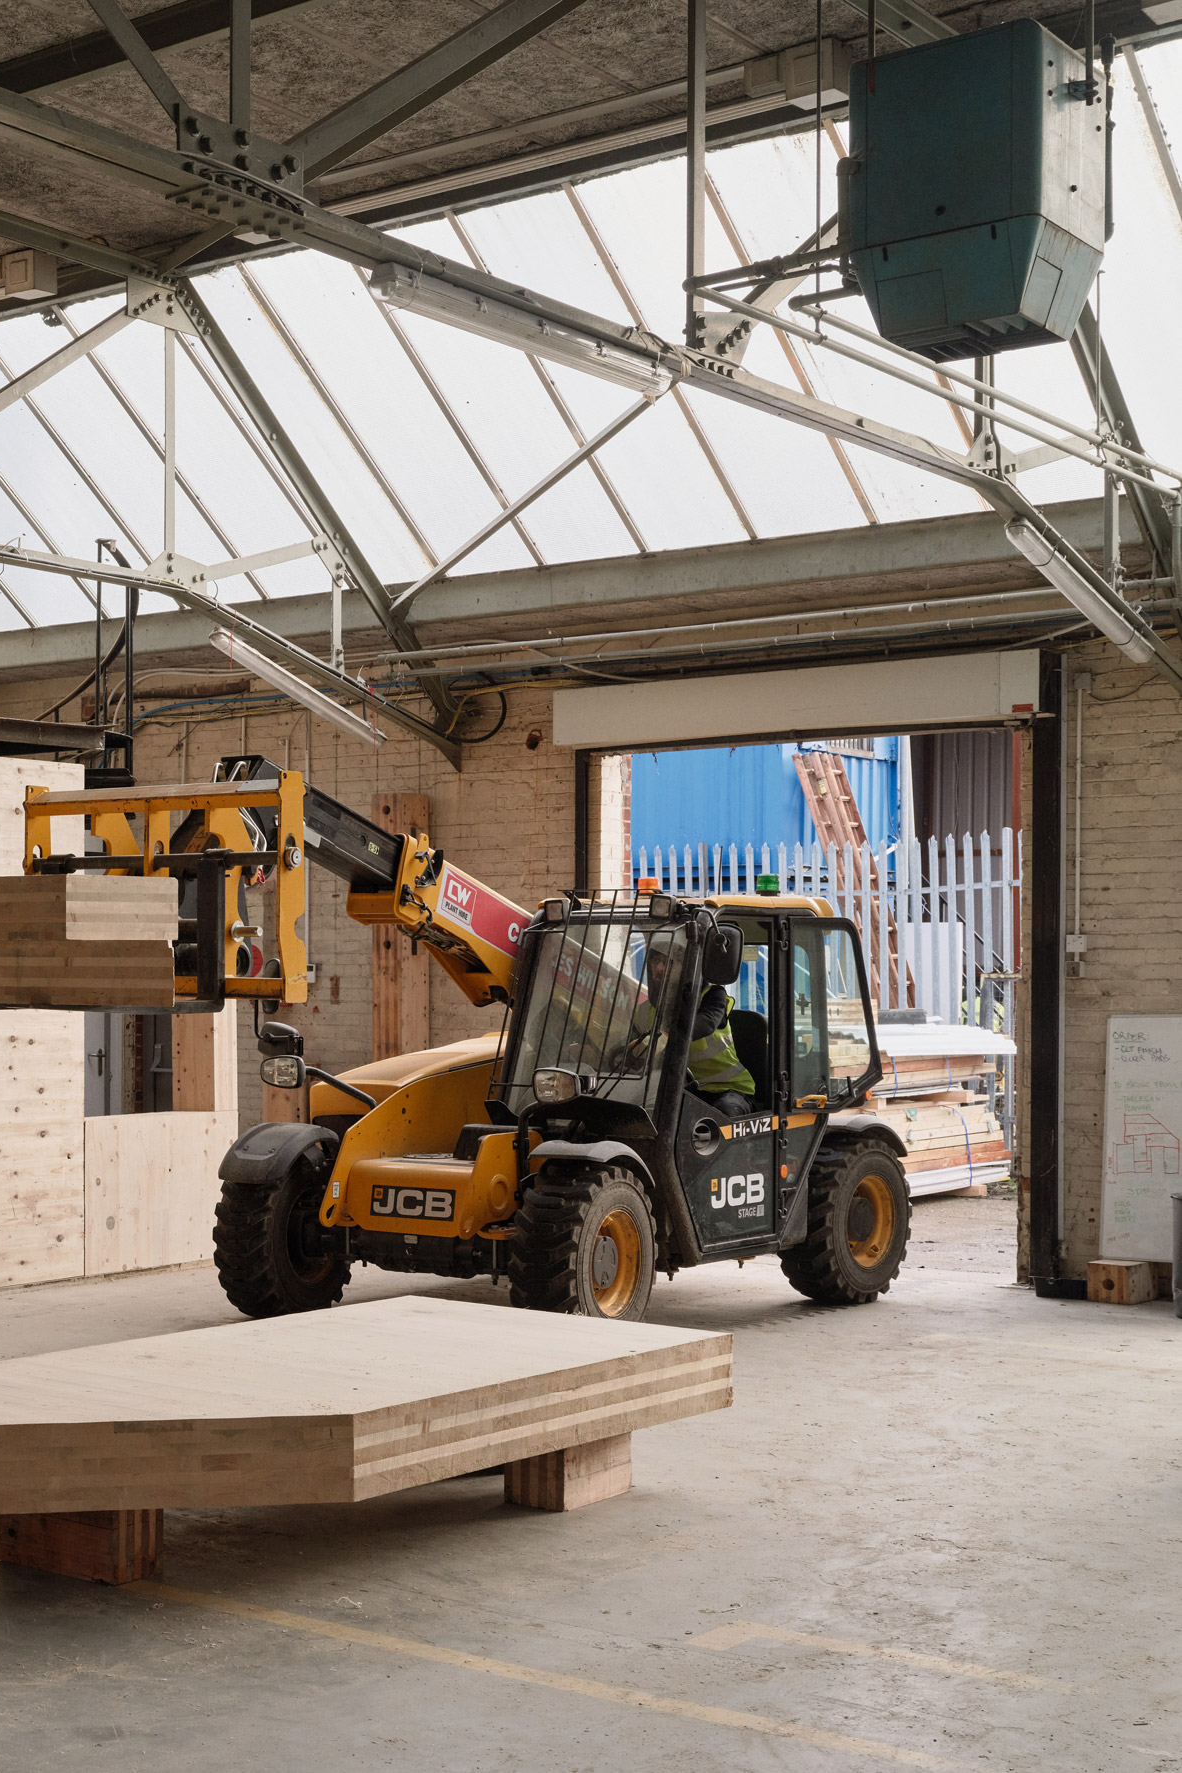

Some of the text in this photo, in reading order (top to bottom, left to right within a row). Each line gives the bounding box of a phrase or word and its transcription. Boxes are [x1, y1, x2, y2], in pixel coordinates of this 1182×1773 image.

[447, 879, 472, 906] CW
[445, 901, 468, 920] PLANT HIRE
[372, 1188, 452, 1218] JCB
[711, 1173, 765, 1209] JCB
[738, 1206, 757, 1218] STAGE
